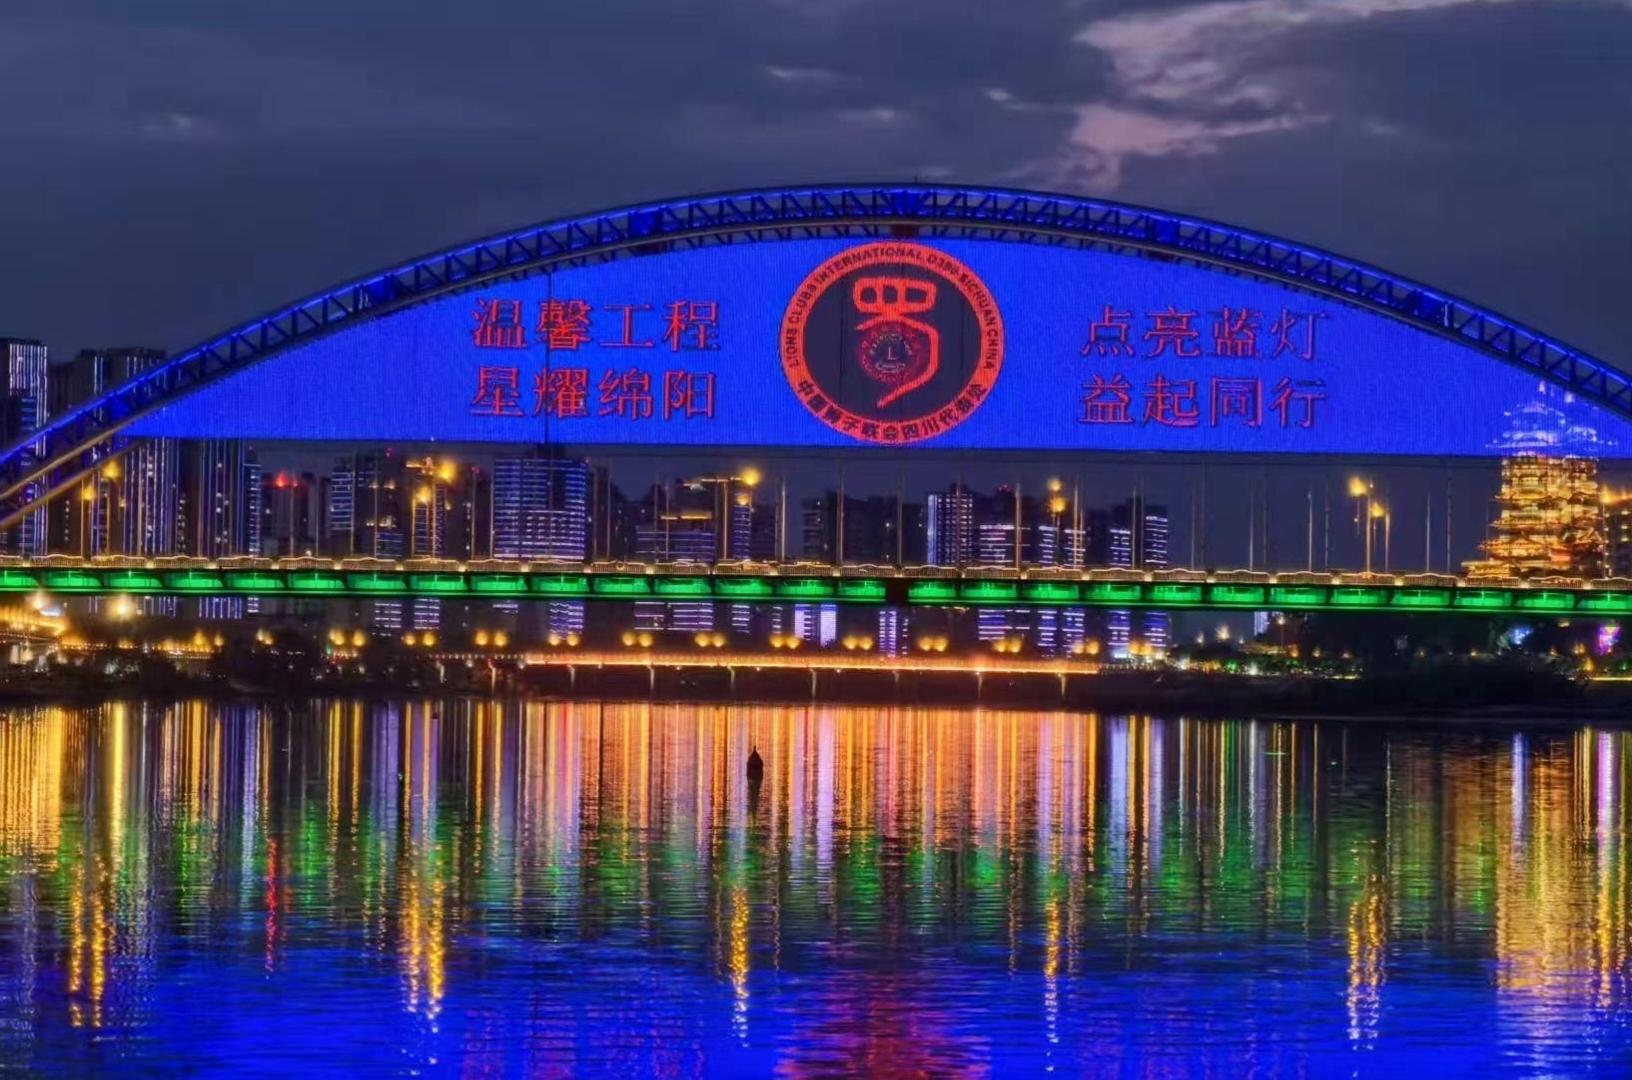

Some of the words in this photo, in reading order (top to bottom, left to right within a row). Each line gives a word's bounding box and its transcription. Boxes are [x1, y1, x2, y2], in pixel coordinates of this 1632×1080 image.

[813, 246, 923, 284] INTERNATIONAL
[471, 298, 719, 351] 温馨工程
[788, 283, 817, 324] CLUBS
[959, 273, 996, 326] SICHUAN
[786, 328, 800, 368] LIONS
[983, 328, 998, 369] CHINA
[1081, 305, 1327, 359] 点亮蓝灯
[470, 365, 716, 420] 星耀绵阳
[1079, 374, 1327, 428] 益起同行
